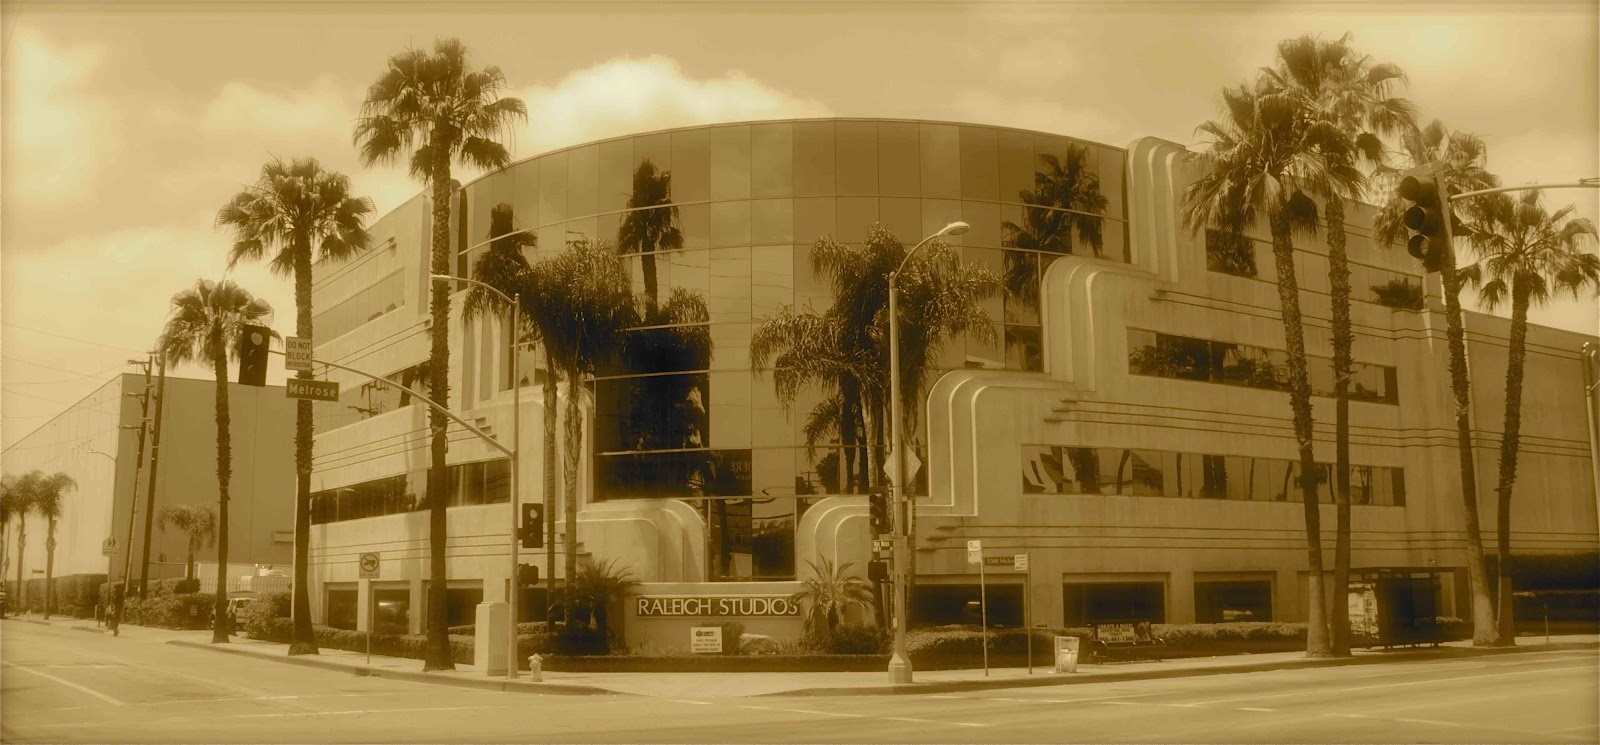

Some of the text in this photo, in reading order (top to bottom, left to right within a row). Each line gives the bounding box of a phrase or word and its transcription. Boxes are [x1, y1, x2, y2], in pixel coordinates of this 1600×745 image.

[287, 340, 311, 350] DO NOT
[287, 351, 311, 361] BLOCK
[289, 383, 336, 397] Melrose
[638, 598, 798, 615] RALEIGH STUDIOS
